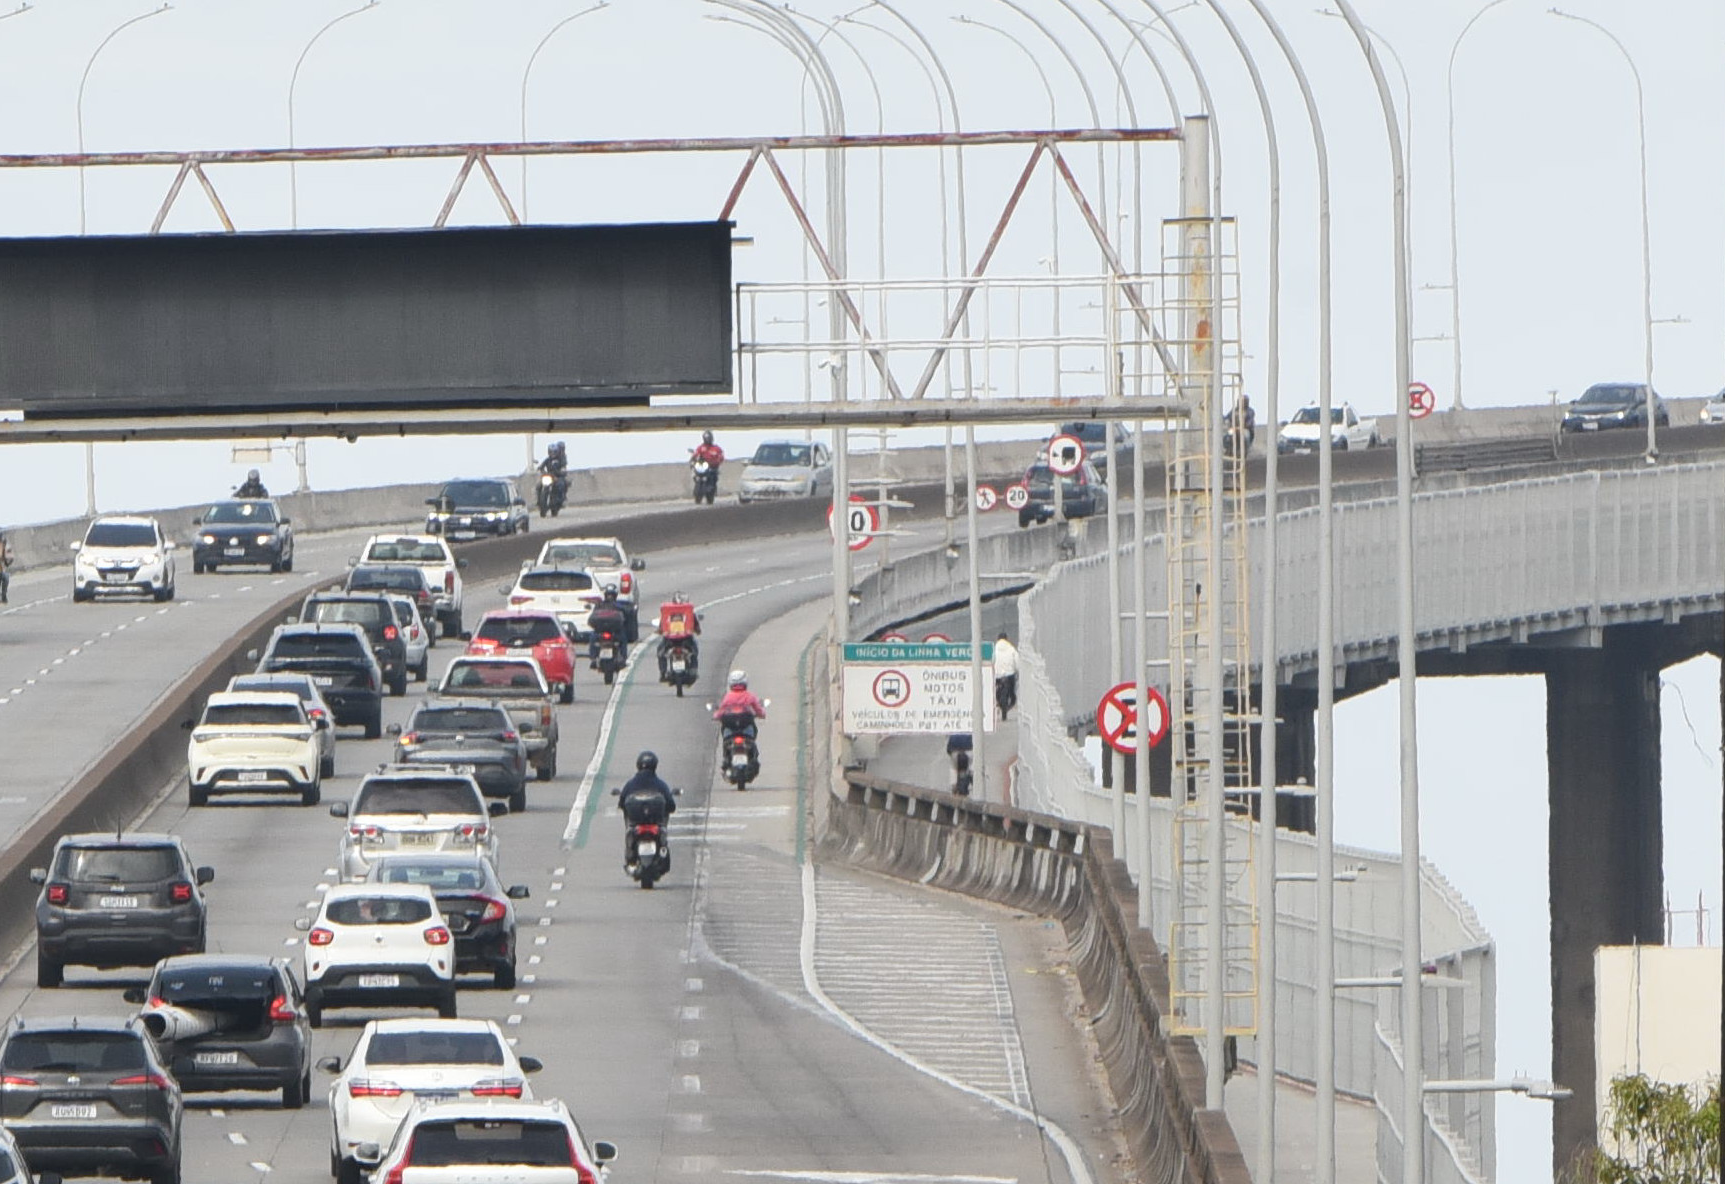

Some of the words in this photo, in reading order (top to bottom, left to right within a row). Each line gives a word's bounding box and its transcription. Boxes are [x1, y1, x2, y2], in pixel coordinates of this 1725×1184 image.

[1009, 490, 1026, 501] 20
[855, 647, 888, 658] INÍCIO
[891, 648, 905, 657] DA
[908, 648, 940, 657] LINHA
[945, 648, 973, 658] VERD
[922, 670, 966, 680] ÔNIBUS
[924, 683, 964, 692] MOTOS
[905, 710, 916, 718] DE
